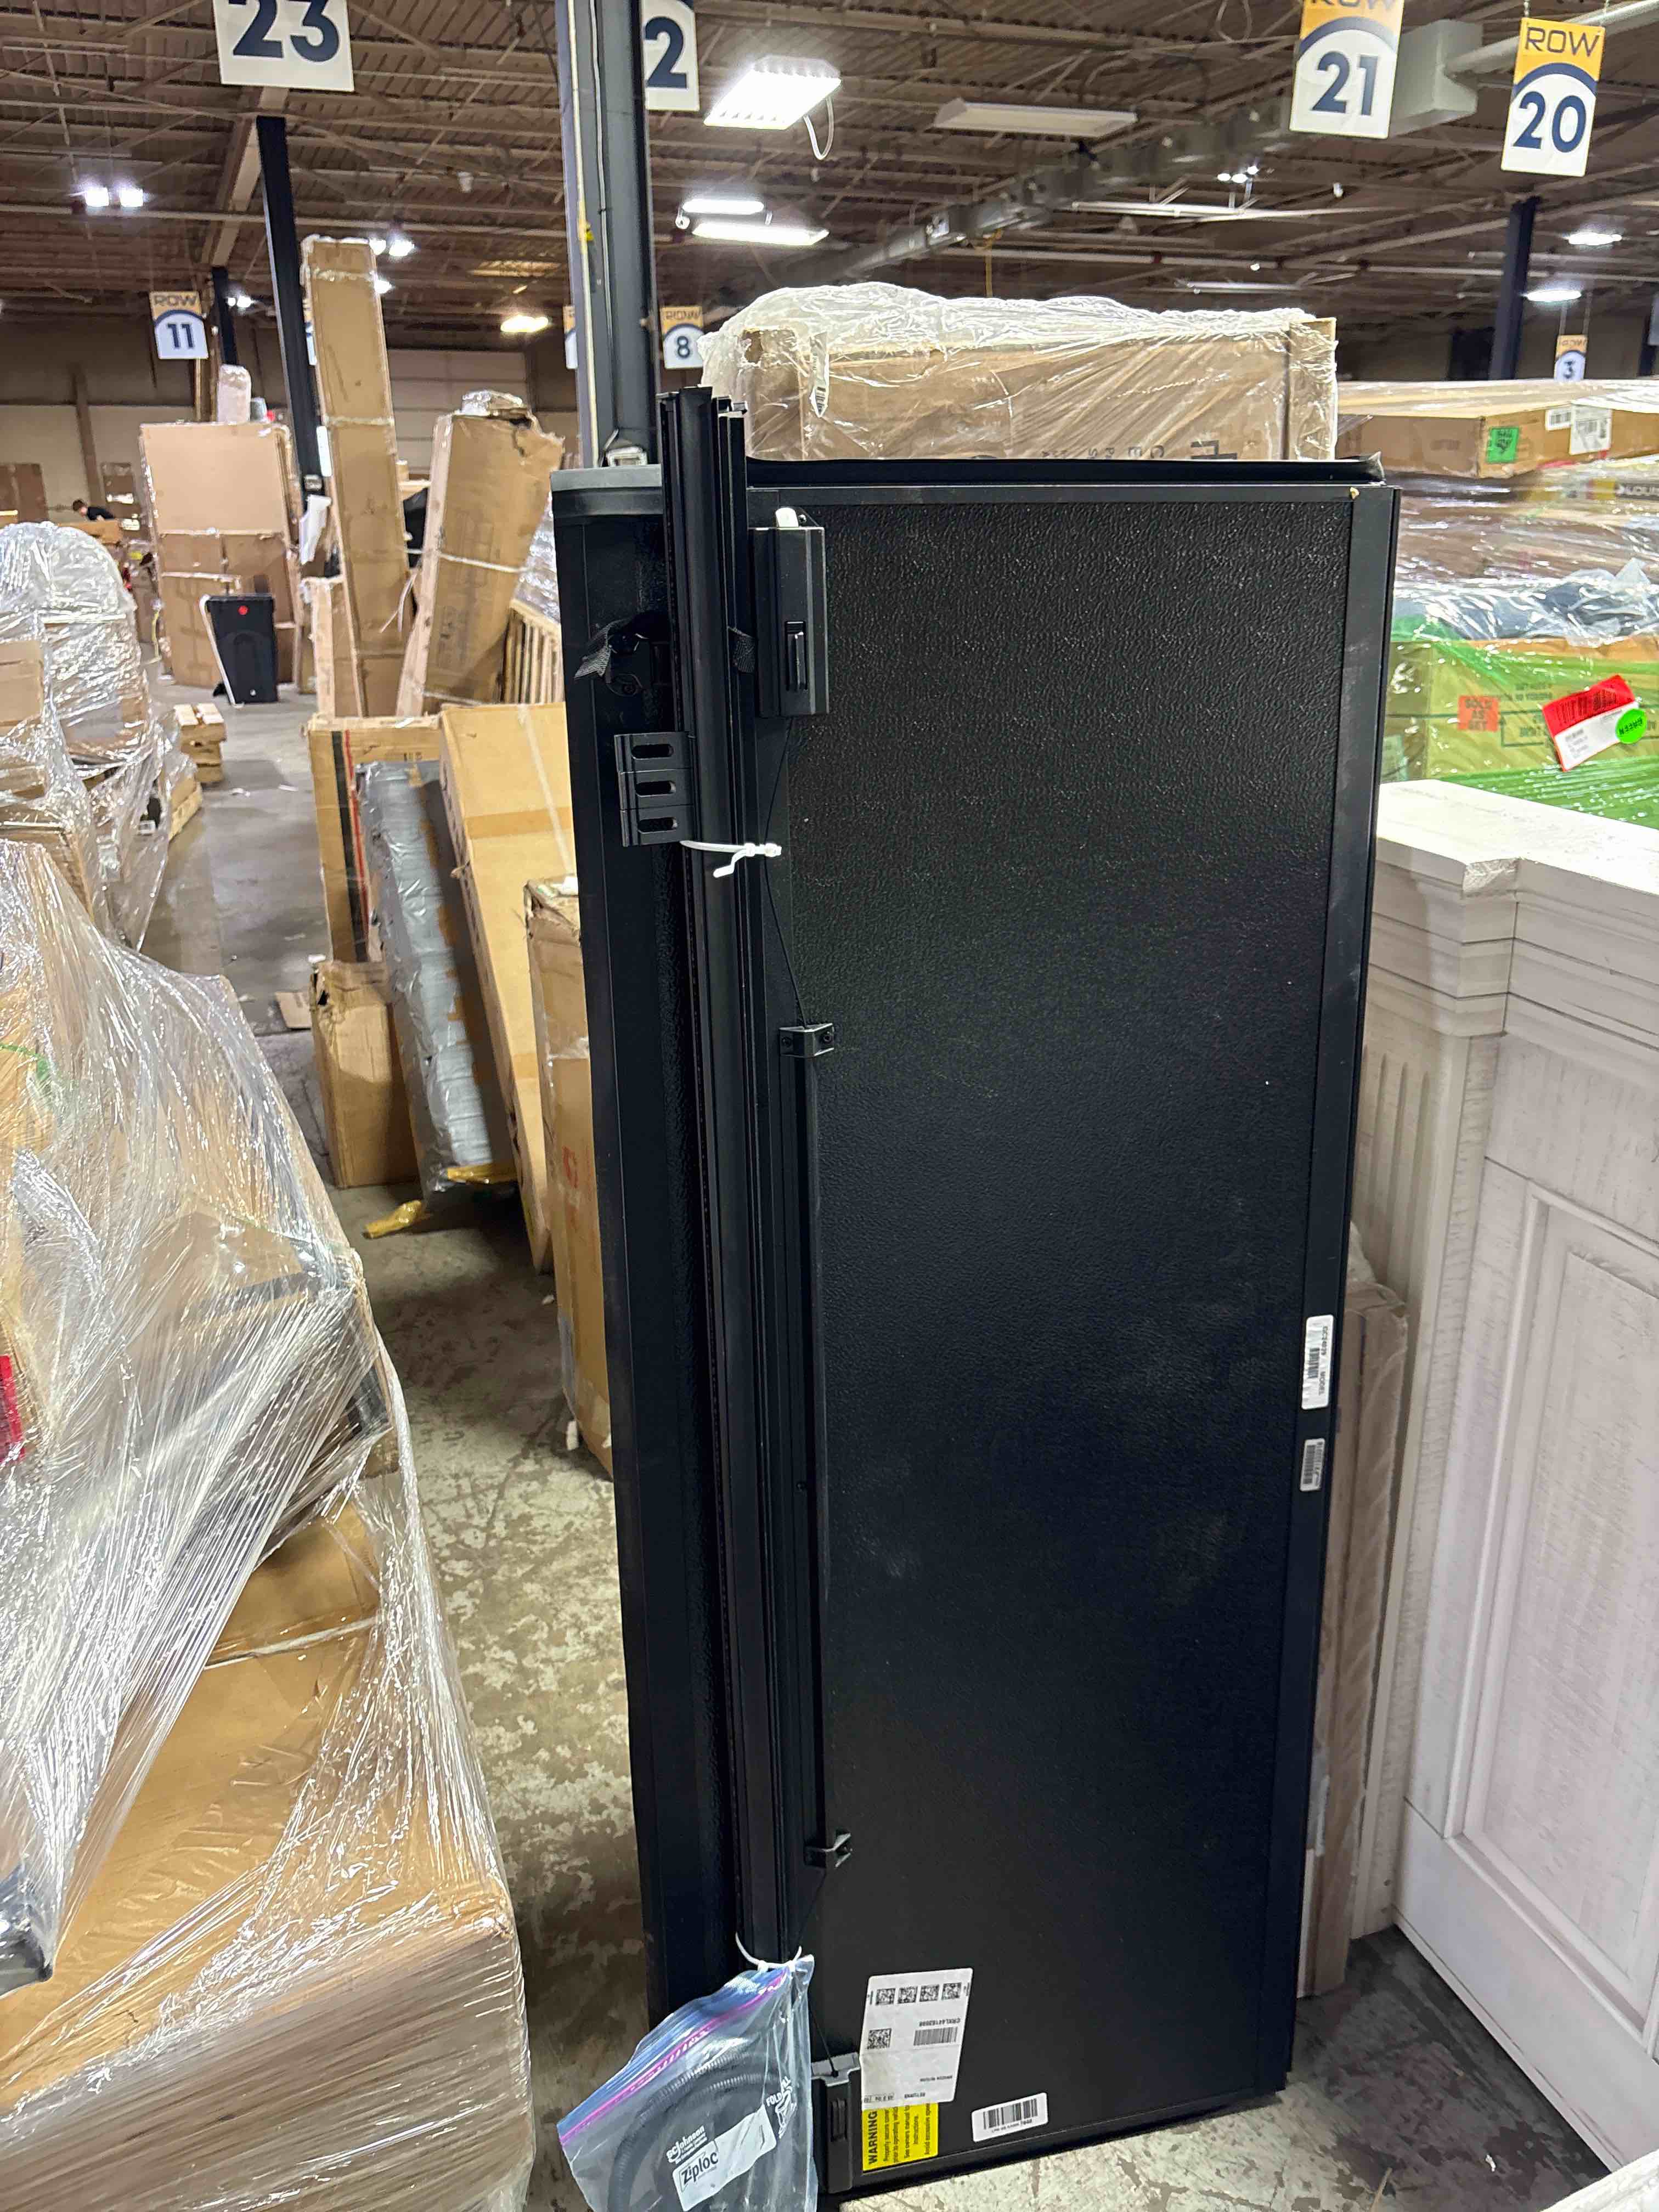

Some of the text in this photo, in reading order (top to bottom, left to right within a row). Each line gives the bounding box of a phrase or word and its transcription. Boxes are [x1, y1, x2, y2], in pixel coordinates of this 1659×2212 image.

[229, 0, 340, 62] 23
[1525, 26, 1600, 57] ROW
[1311, 51, 1379, 116] 21
[1513, 91, 1587, 153] 20
[154, 296, 198, 306] ROW
[665, 311, 701, 320] ROW
[167, 323, 194, 348] 11
[677, 336, 690, 359] 8
[1563, 360, 1576, 379] 3
[1619, 719, 1644, 735] GREEN
[766, 2093, 783, 2107] FOLD
[868, 2111, 878, 2165] WARNING
[681, 2152, 719, 2185] Ziploc
